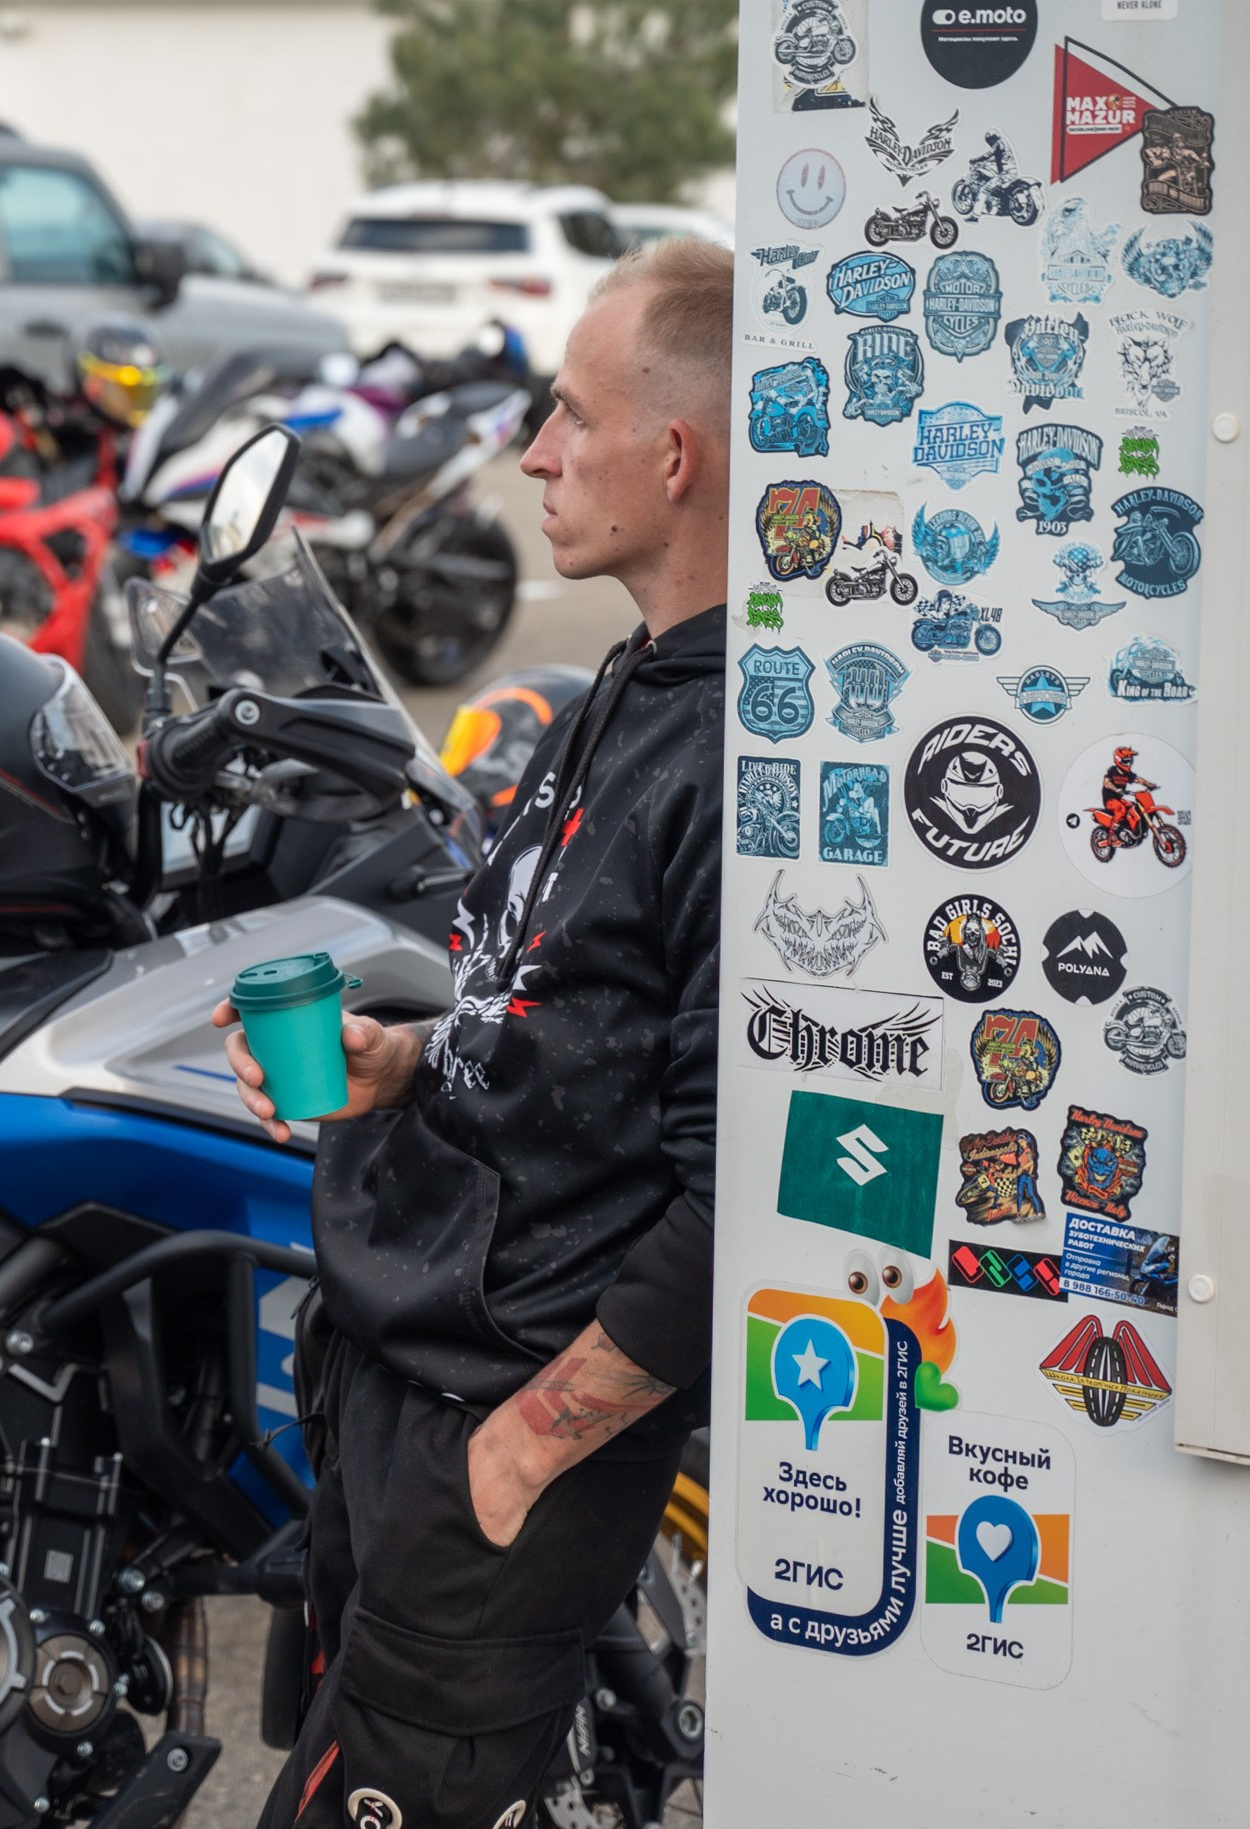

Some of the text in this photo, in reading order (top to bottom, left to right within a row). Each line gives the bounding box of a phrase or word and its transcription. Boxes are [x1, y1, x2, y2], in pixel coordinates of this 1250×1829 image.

[957, 6, 1027, 24] e.moto
[1117, 0, 1162, 10] NEVER ALONE
[1066, 96, 1108, 110] MAX
[1066, 110, 1136, 124] MAZUR
[840, 272, 911, 309] DAVIDSON
[944, 281, 981, 293] MOTOR
[929, 297, 995, 312] HARLEY-DAVIDSON
[943, 316, 979, 332] CYCLES
[744, 334, 762, 344] BAR
[781, 340, 815, 350] GRILL
[857, 333, 915, 361] RIDE
[913, 437, 1005, 463] DAVIDSON
[1114, 489, 1204, 522] HARLEY-DAVIDSON
[1037, 521, 1067, 534] 1903
[1119, 573, 1186, 596] MOTORCYCLES
[753, 659, 800, 676] ROUTE
[1117, 680, 1188, 698] KING OF THE ROAD
[750, 683, 800, 725] 66
[917, 723, 1032, 776] RIDERS
[774, 761, 797, 775] RIDE
[911, 808, 1031, 862] FUTURE
[823, 847, 883, 863] GARAGE
[927, 898, 1018, 966] BAD GIRLS SOCHI
[941, 971, 953, 980] EST
[1058, 962, 1110, 977] POLYANA
[1132, 989, 1161, 1002] CUSTOM
[747, 1003, 930, 1078] Chrome
[1124, 1056, 1165, 1070] MOTORCYCLES
[1068, 1217, 1136, 1241] ДОСТАВКА
[1068, 1230, 1145, 1253] ЗУБОТЕХНИЧЕСКИХ
[1068, 1239, 1095, 1250] РАБОТ
[1065, 1253, 1101, 1266] Отправка
[1070, 1261, 1096, 1275] другие
[1064, 1269, 1090, 1280] города
[1063, 1280, 1146, 1306] 8 988 166-50-40
[897, 1340, 908, 1379] 2ГИС
[895, 1392, 910, 1439] друзей
[948, 1435, 1051, 1470] Вкусный
[779, 1461, 847, 1491] Здесь
[894, 1441, 906, 1504] добавляй
[969, 1466, 1029, 1492] кофе
[763, 1486, 861, 1518] хорошо!
[891, 1509, 910, 1593] лучше
[774, 1558, 843, 1590] 2ГИС
[770, 1613, 782, 1630] а
[788, 1617, 800, 1633] с
[805, 1597, 904, 1647] друзьями
[966, 1633, 1024, 1659] 2ГИС
